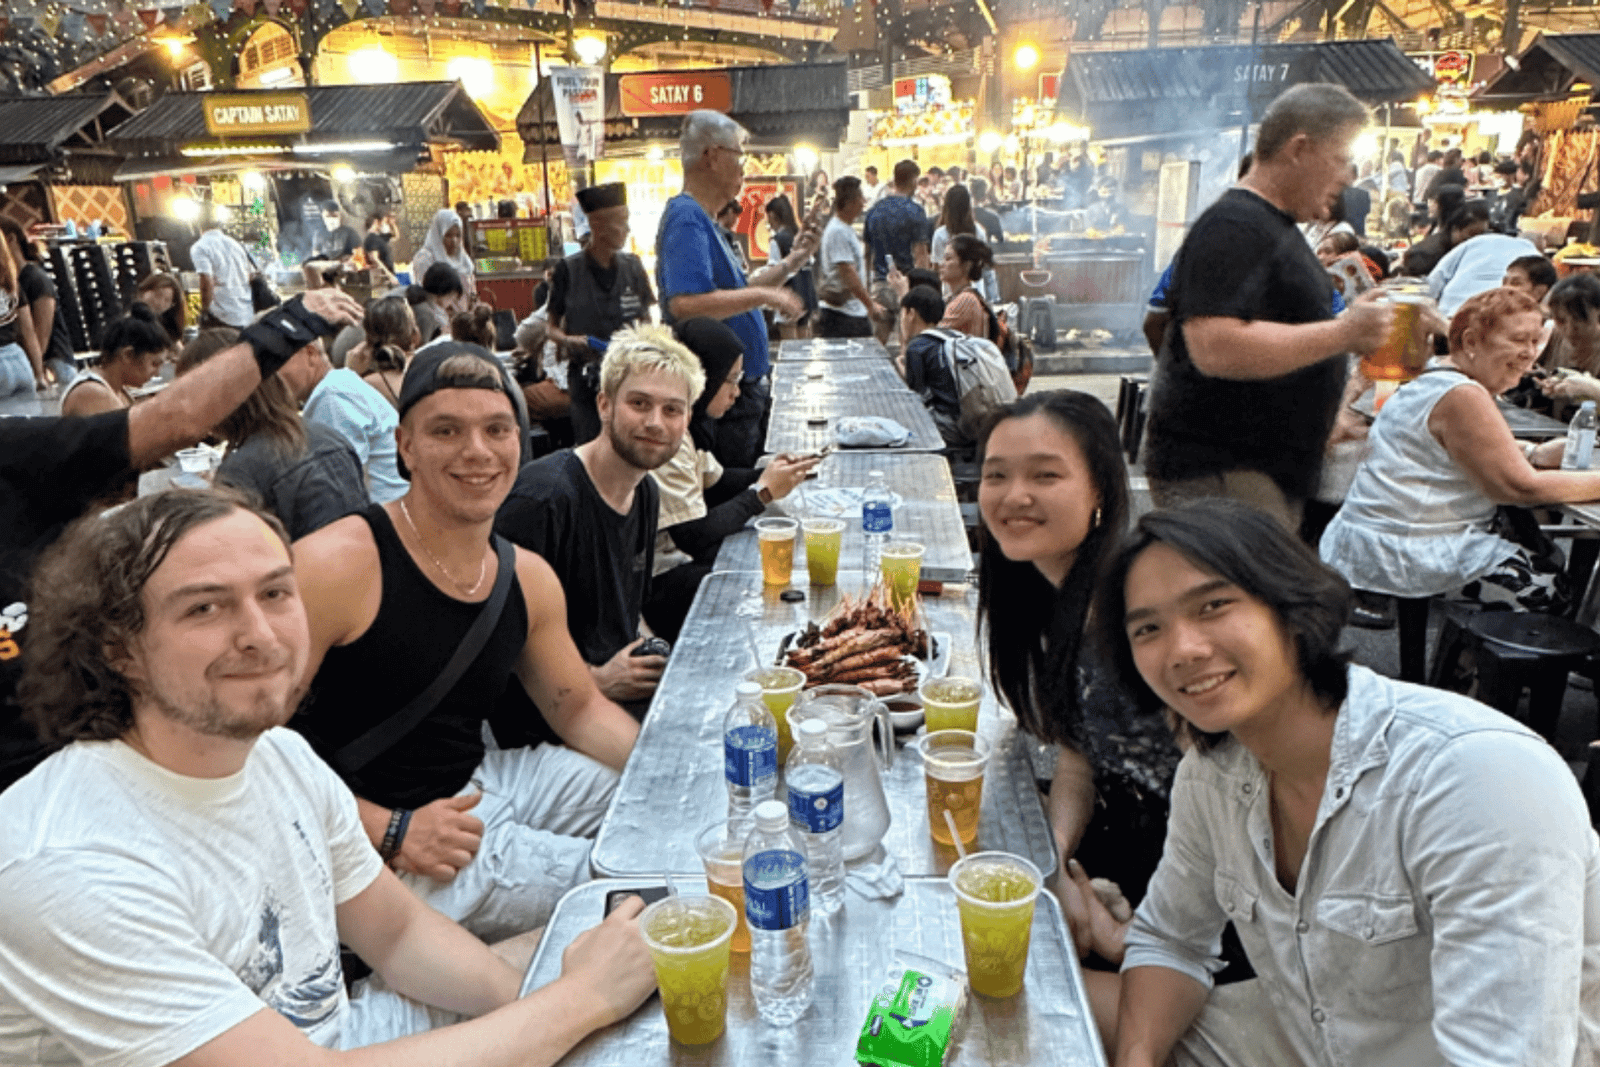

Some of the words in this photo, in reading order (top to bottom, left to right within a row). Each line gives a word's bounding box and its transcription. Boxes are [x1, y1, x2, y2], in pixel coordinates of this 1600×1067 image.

[1234, 64, 1276, 82] SATAY
[1281, 62, 1290, 81] 7
[650, 85, 690, 104] SATAY
[693, 84, 703, 103] 6
[213, 106, 264, 124] CAPTAIN
[264, 104, 300, 123] SATAY
